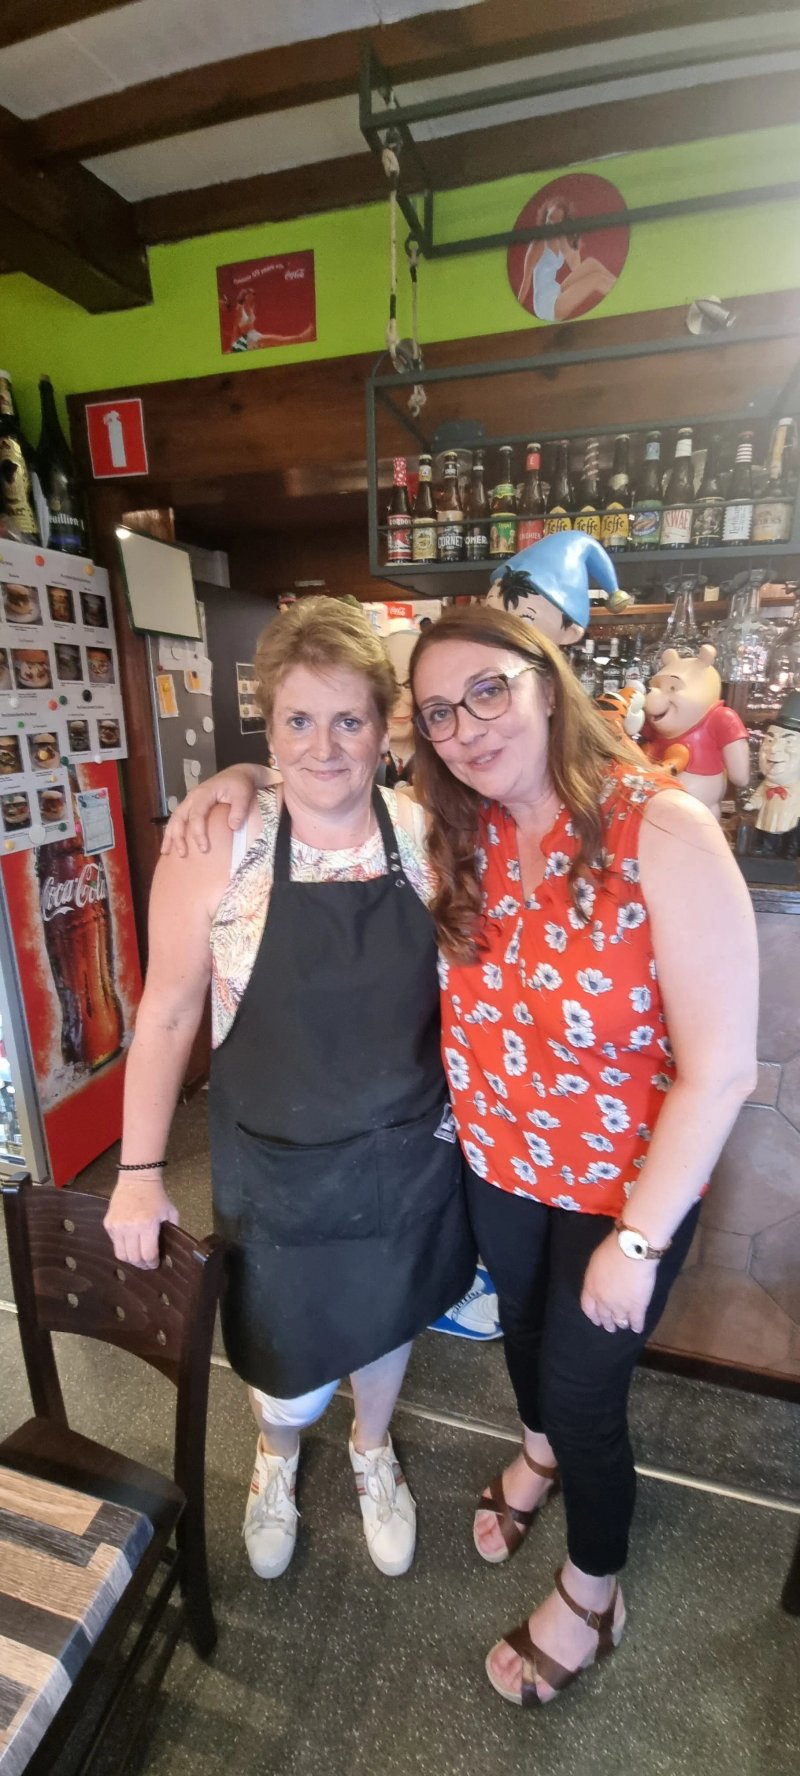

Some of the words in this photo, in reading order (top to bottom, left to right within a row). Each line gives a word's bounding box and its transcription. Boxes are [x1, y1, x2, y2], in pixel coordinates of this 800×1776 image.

[604, 514, 625, 534] Leffe
[437, 535, 463, 549] CORNET
[41, 863, 107, 922] Coca-Cola
